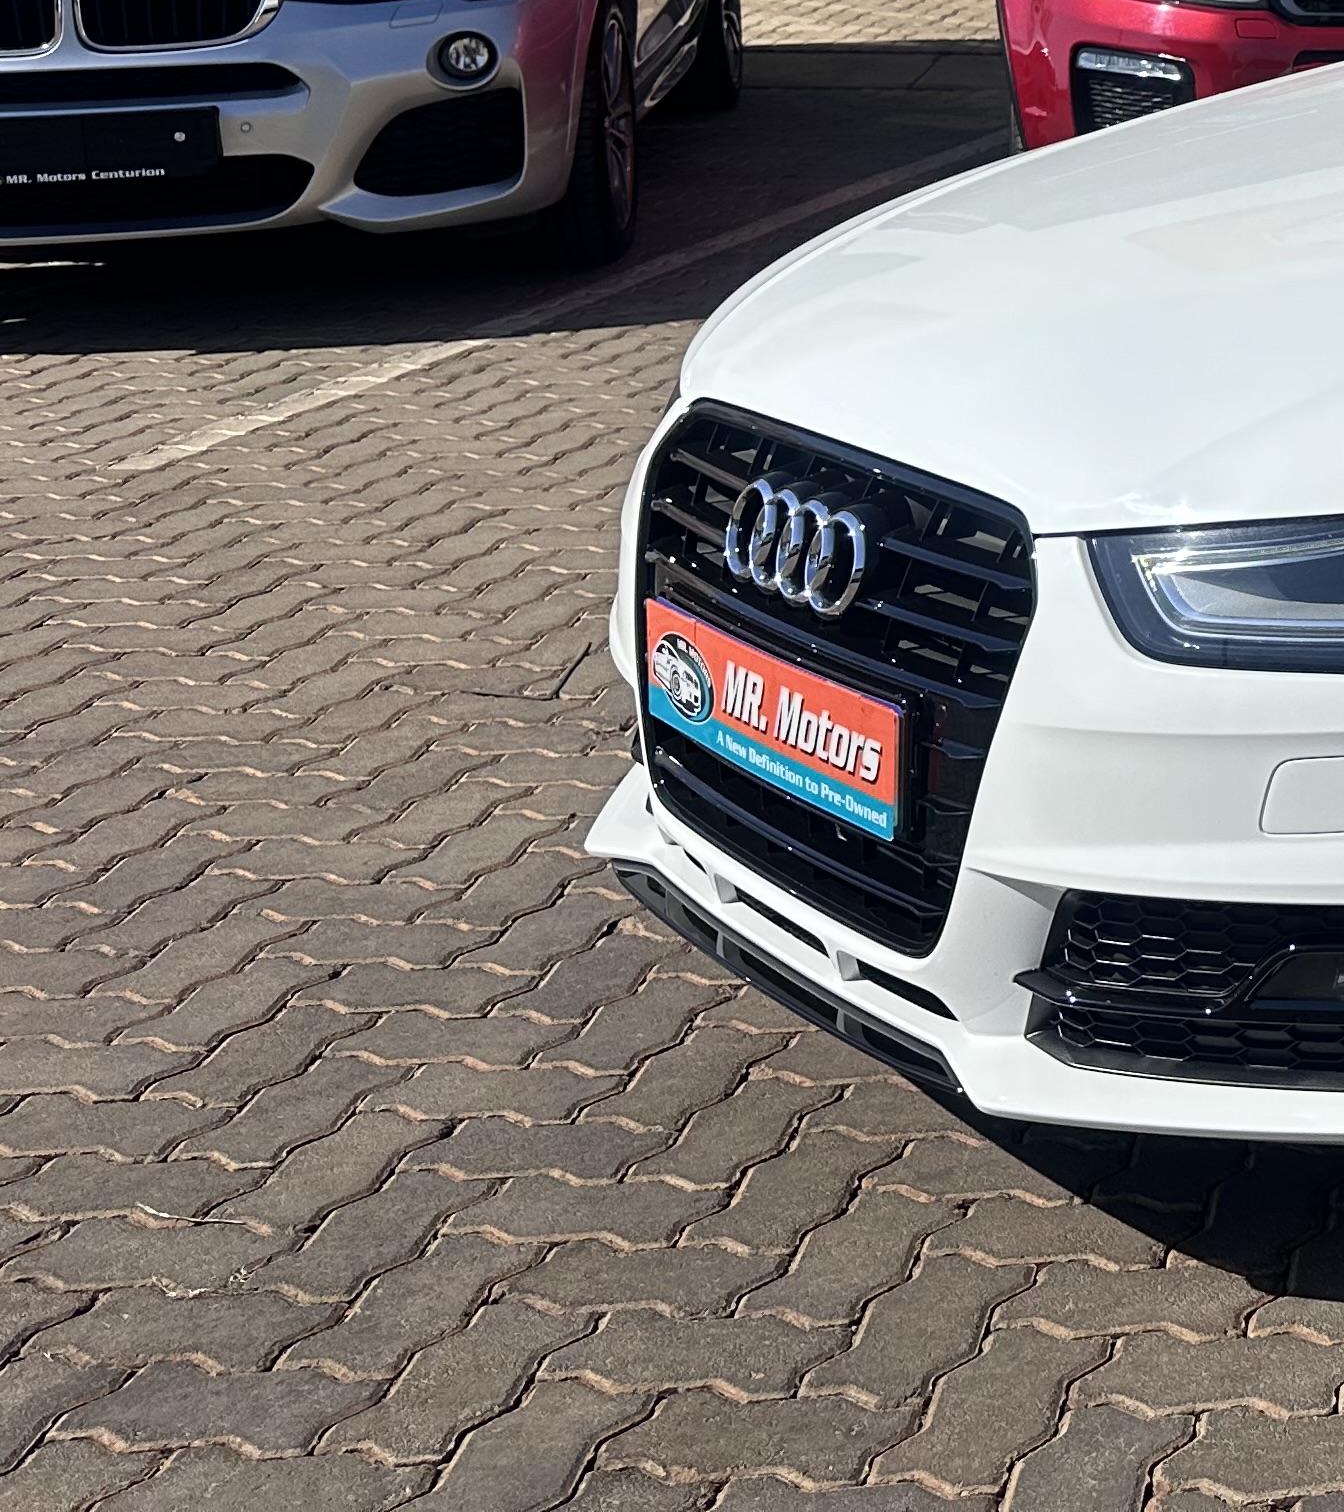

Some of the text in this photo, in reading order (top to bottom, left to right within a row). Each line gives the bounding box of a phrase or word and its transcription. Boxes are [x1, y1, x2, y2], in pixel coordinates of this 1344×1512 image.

[6, 167, 166, 185] MR. Motors Centurion
[720, 659, 883, 784] MR. Motors
[716, 730, 888, 829] A New Definition to Pre-Owned
